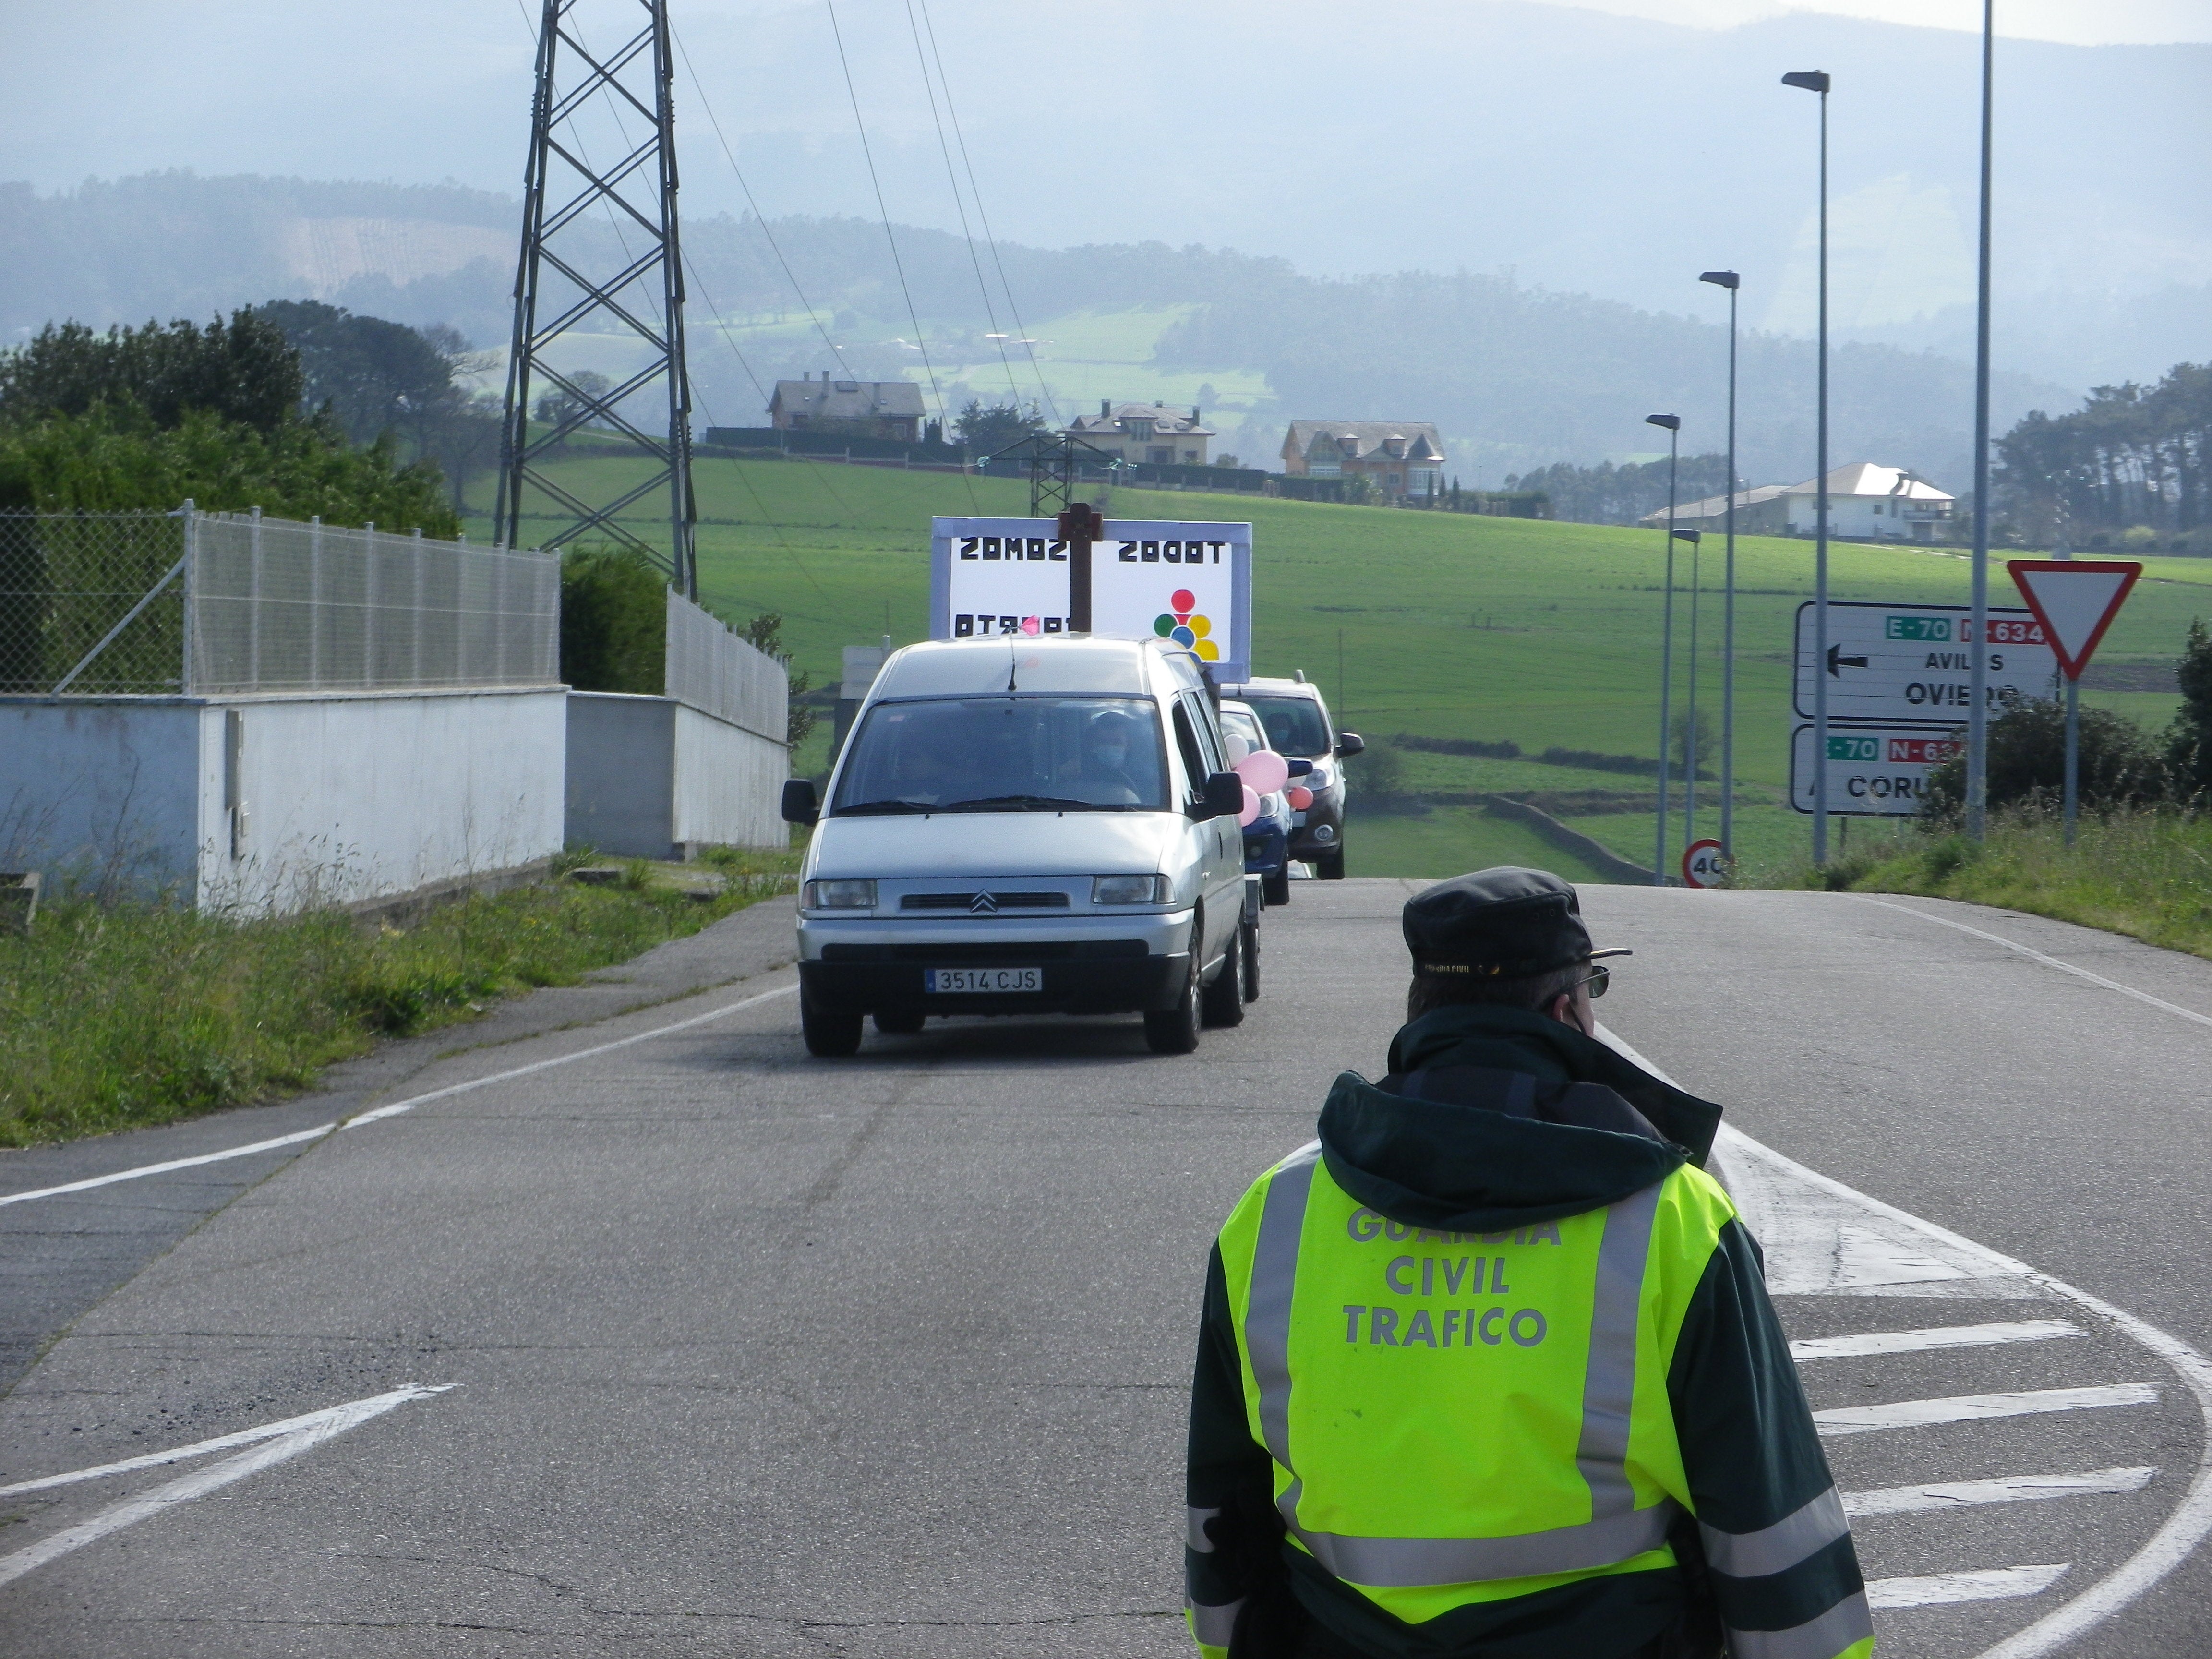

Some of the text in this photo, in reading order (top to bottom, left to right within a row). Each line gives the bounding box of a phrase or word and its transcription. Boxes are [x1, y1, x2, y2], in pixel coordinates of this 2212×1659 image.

[1925, 652, 2004, 671] AVILS
[1906, 682, 2019, 706] OVIEO
[1827, 740, 1876, 758] -70
[1848, 775, 1931, 799] CORU
[941, 971, 1036, 989] 3514 CJS
[1385, 1255, 1510, 1296] CIVIL
[1343, 1305, 1548, 1348] TRAFICO
